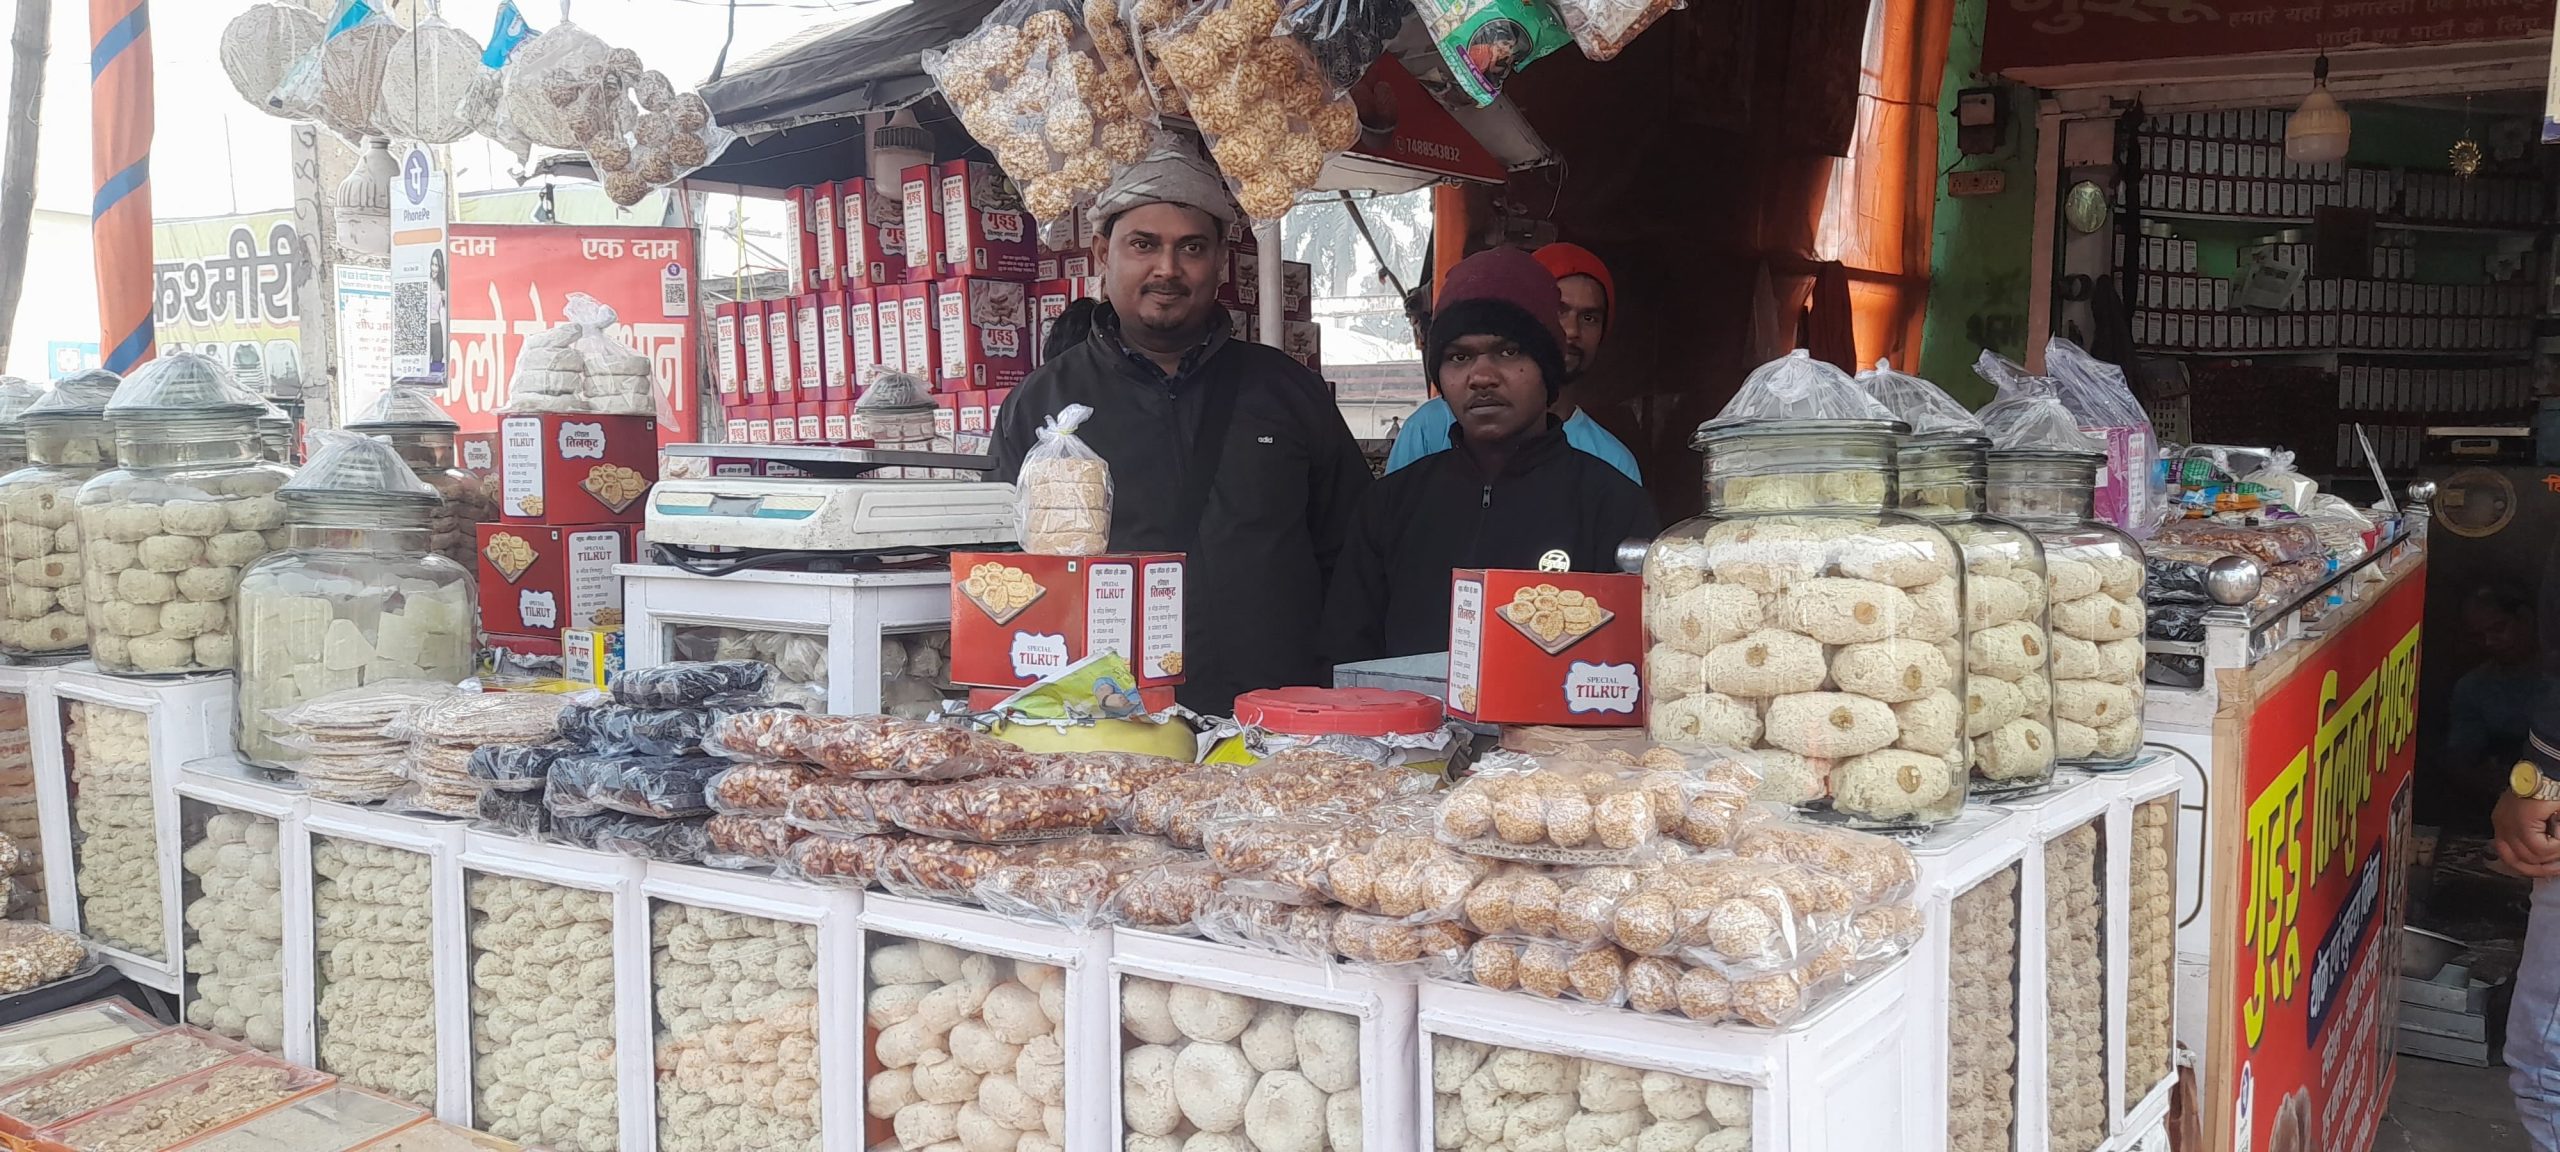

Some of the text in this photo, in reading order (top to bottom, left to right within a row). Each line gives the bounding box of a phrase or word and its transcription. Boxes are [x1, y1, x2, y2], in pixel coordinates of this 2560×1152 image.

[403, 209, 430, 222] PhonePe
[450, 236, 497, 257] दाम
[581, 238, 680, 261] एक दाम
[509, 438, 535, 448] TILKUT
[566, 434, 599, 451] तिलकुट
[578, 551, 612, 562] TILKUT
[1096, 588, 1125, 599] TILKUT
[1151, 585, 1176, 600] तिलकुट
[525, 606, 551, 619] TILKUT
[1019, 652, 1060, 667] TILKUT
[1587, 676, 1619, 684] SPECIAL
[1576, 685, 1629, 699] TILKUT
[2311, 667, 2378, 888] तिलकुट
[2376, 621, 2420, 773] भण्डार
